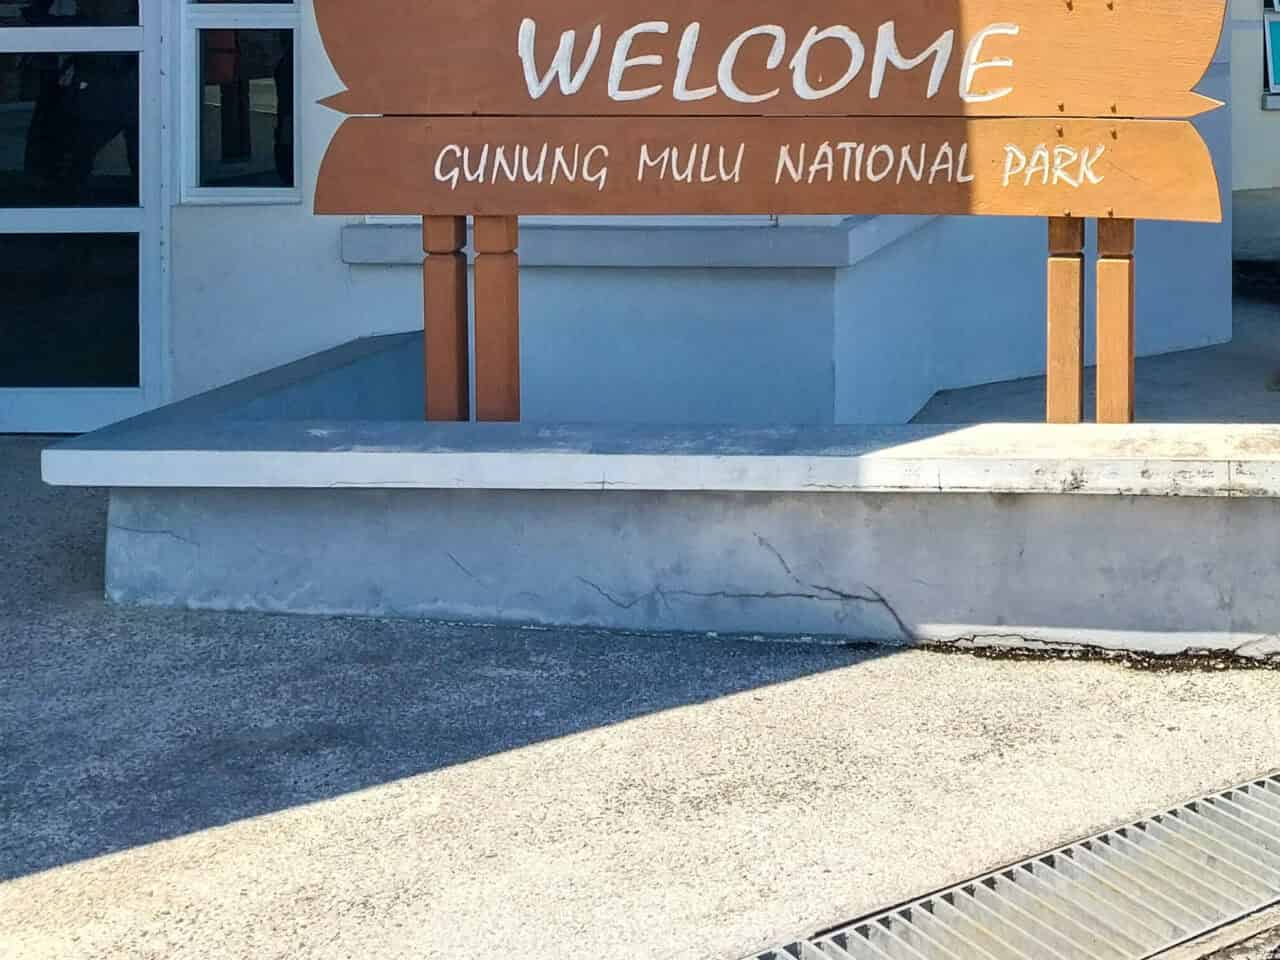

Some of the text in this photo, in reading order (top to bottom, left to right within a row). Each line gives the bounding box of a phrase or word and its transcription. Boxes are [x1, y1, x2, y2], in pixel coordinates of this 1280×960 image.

[517, 17, 1020, 103] WELCOME
[434, 142, 1106, 191] GUNUNG MULU NATIONAL PARK
